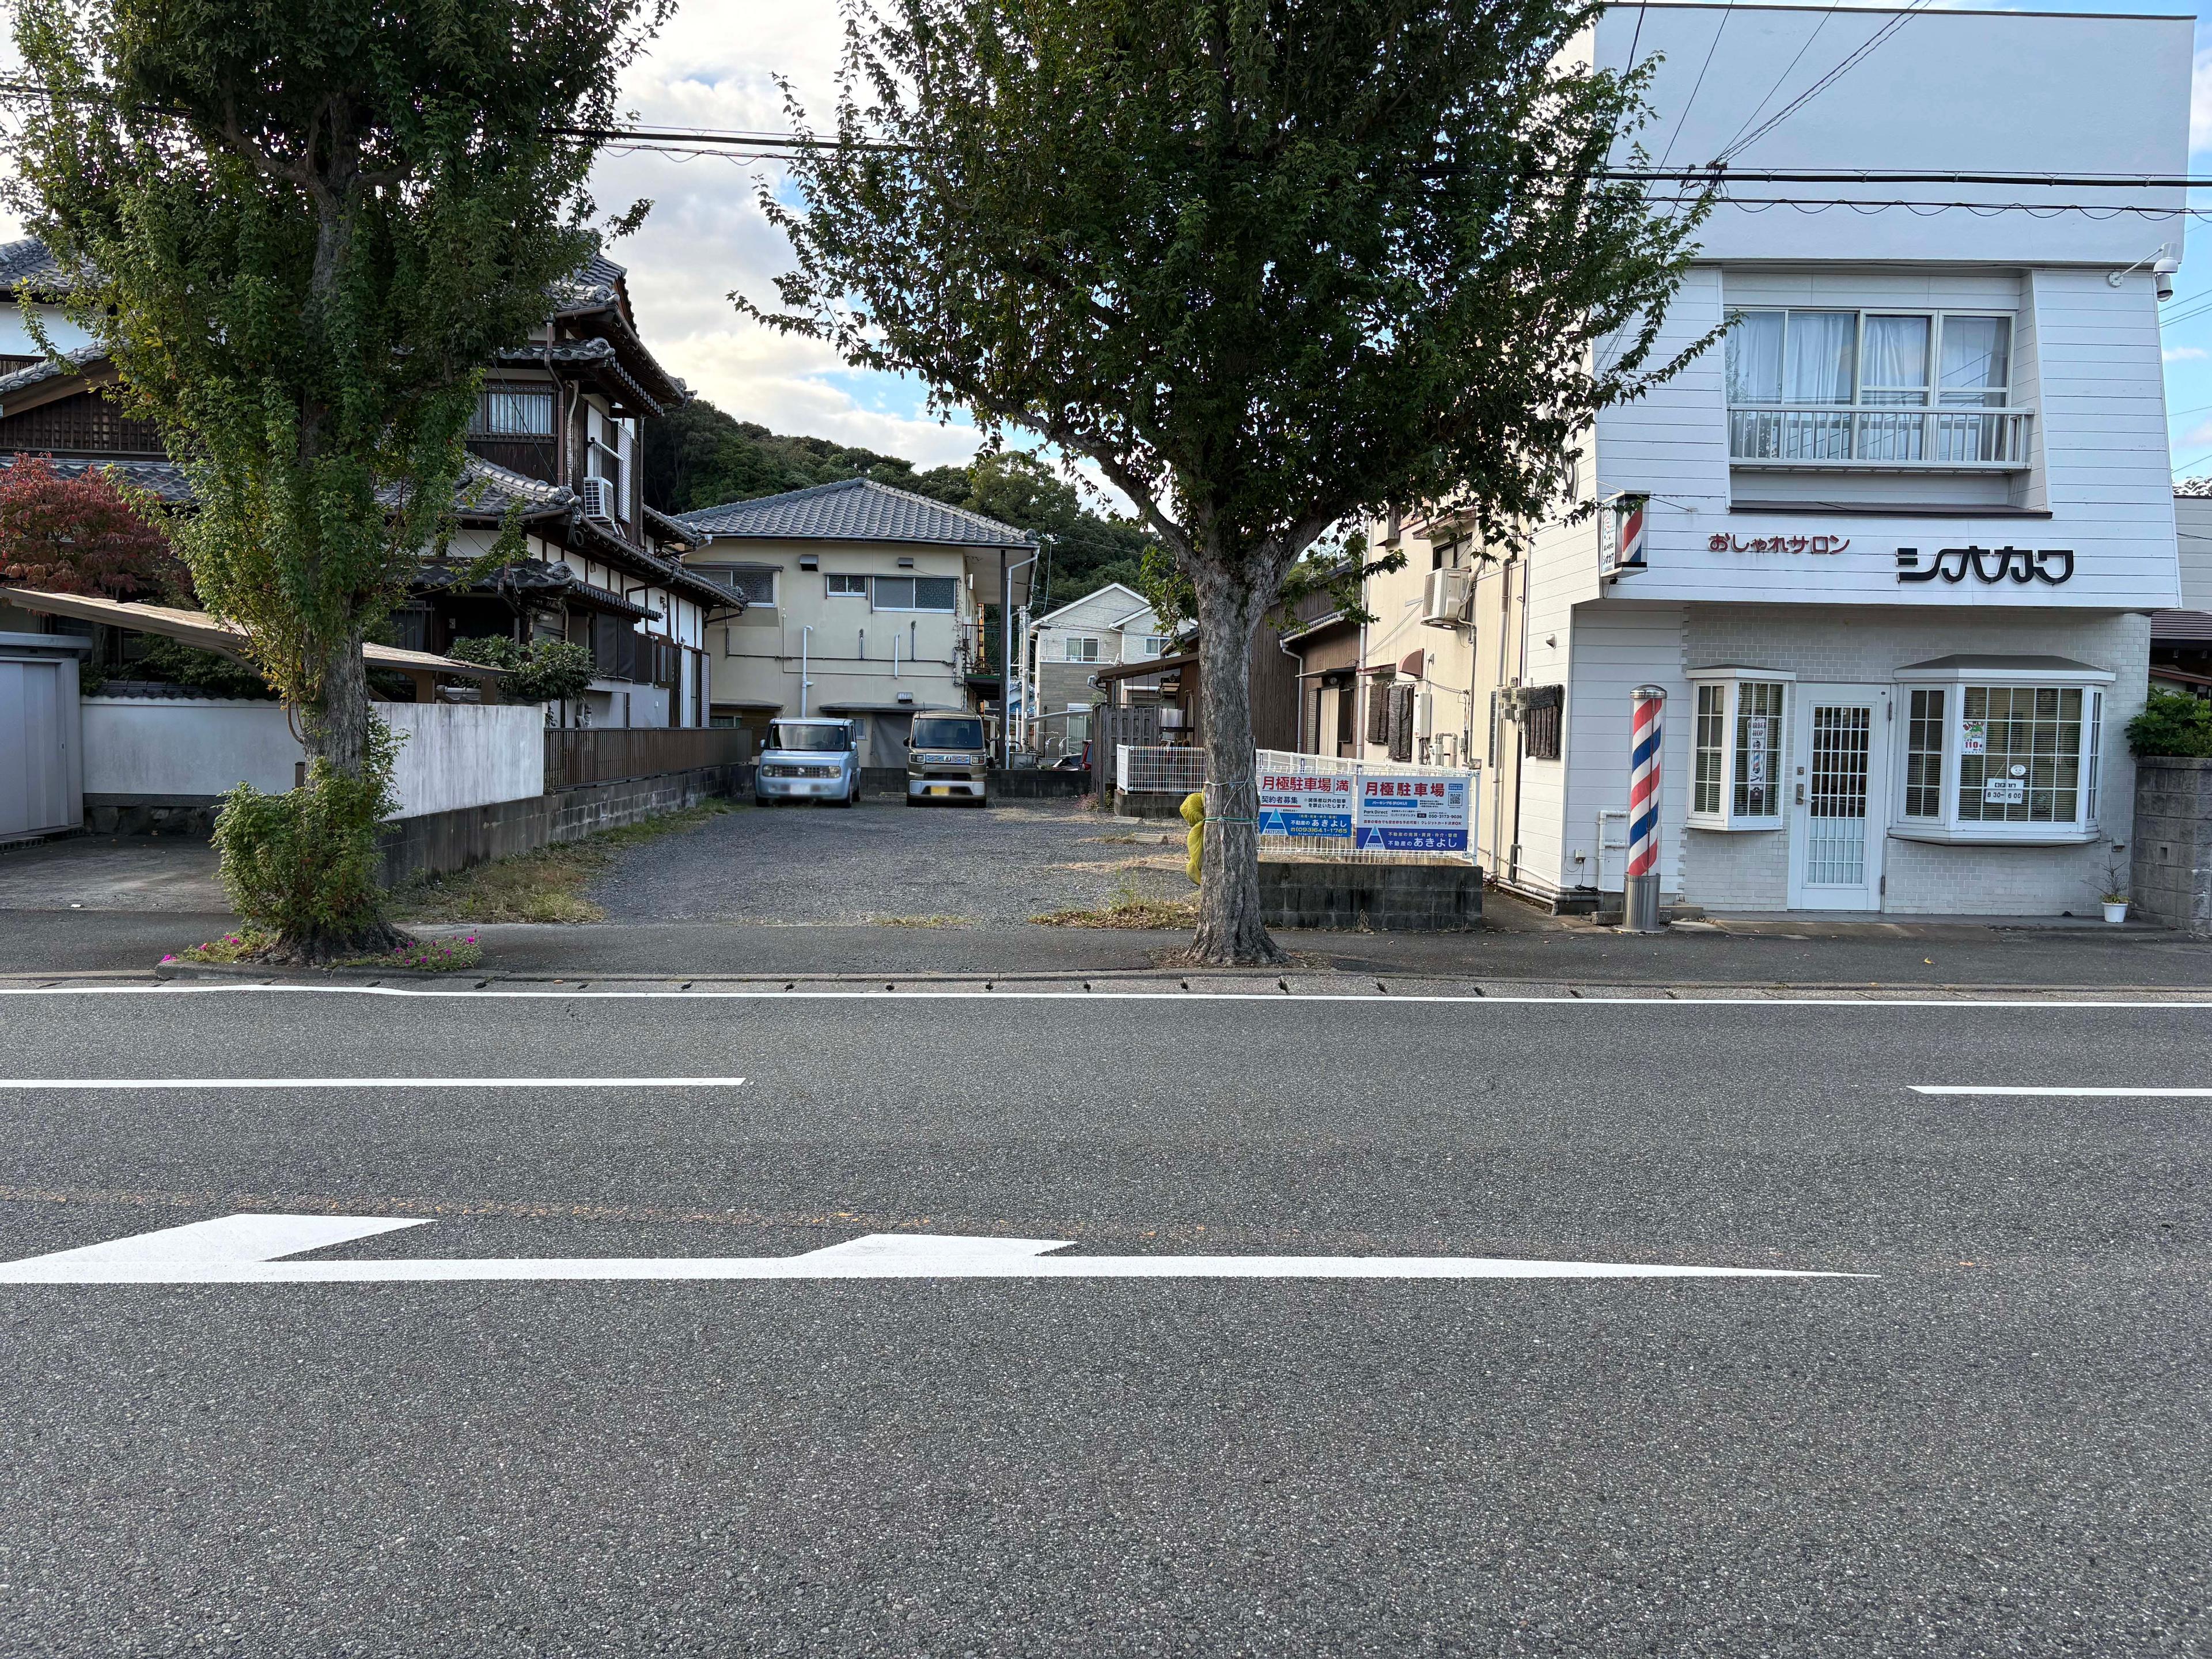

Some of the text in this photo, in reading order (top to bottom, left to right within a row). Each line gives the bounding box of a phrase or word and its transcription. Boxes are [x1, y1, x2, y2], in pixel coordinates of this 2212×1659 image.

[1709, 534, 1850, 554] おしゃれサロン
[1896, 546, 2074, 584] シオカワ
[1262, 776, 1331, 791] 月極駐車場
[1336, 780, 1349, 791] 満
[1365, 782, 1445, 797] 月極駐車場
[1262, 796, 1298, 804] 契約者募集
